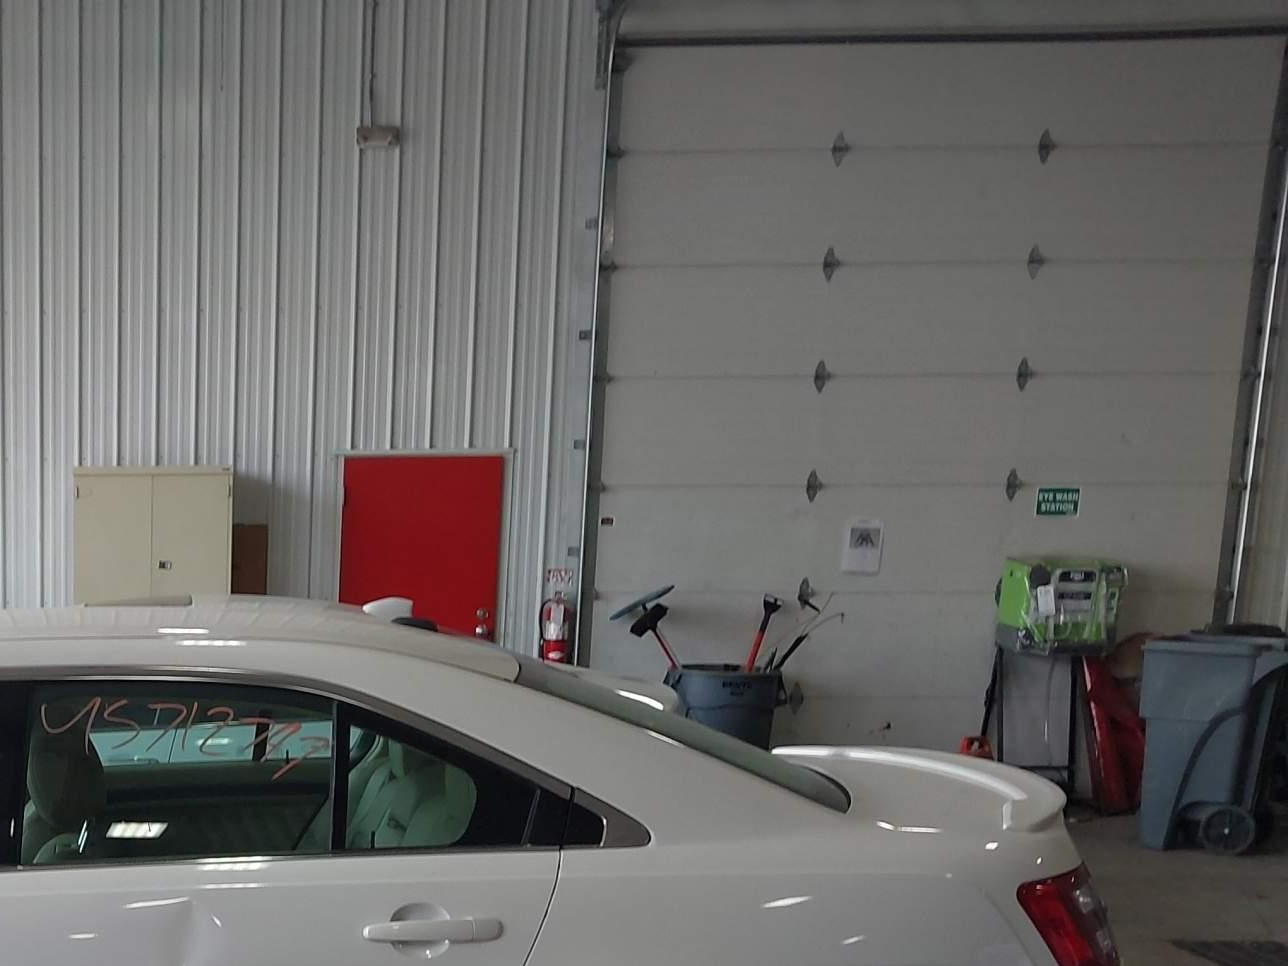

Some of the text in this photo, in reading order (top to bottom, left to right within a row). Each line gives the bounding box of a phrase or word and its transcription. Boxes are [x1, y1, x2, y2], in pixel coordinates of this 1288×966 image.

[1039, 490, 1079, 502] EYE WASH
[1041, 502, 1074, 513] STATION
